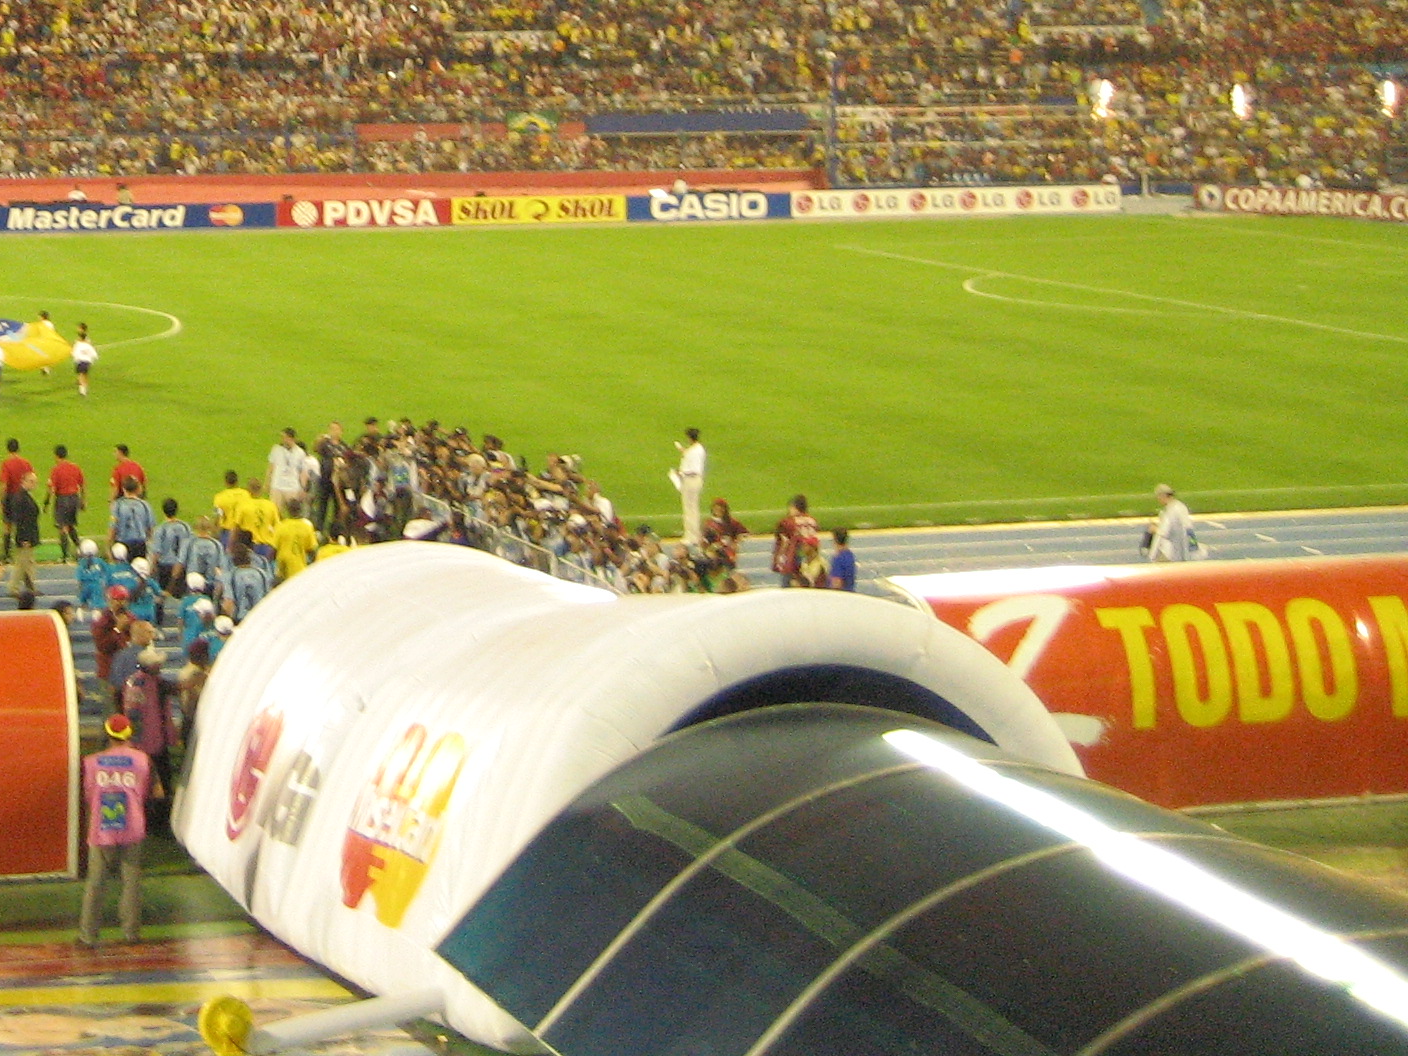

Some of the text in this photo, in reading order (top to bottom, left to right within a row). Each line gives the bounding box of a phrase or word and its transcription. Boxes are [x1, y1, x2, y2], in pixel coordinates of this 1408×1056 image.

[323, 198, 439, 227] PDVSA
[650, 192, 769, 220] CASIO
[818, 192, 1116, 211] LG LG LG LG LG LG
[1224, 187, 1408, 221] COPAAMERICA.C
[7, 205, 186, 230] MasterCard
[1096, 597, 1358, 730] TODO
[96, 770, 136, 788] 046
